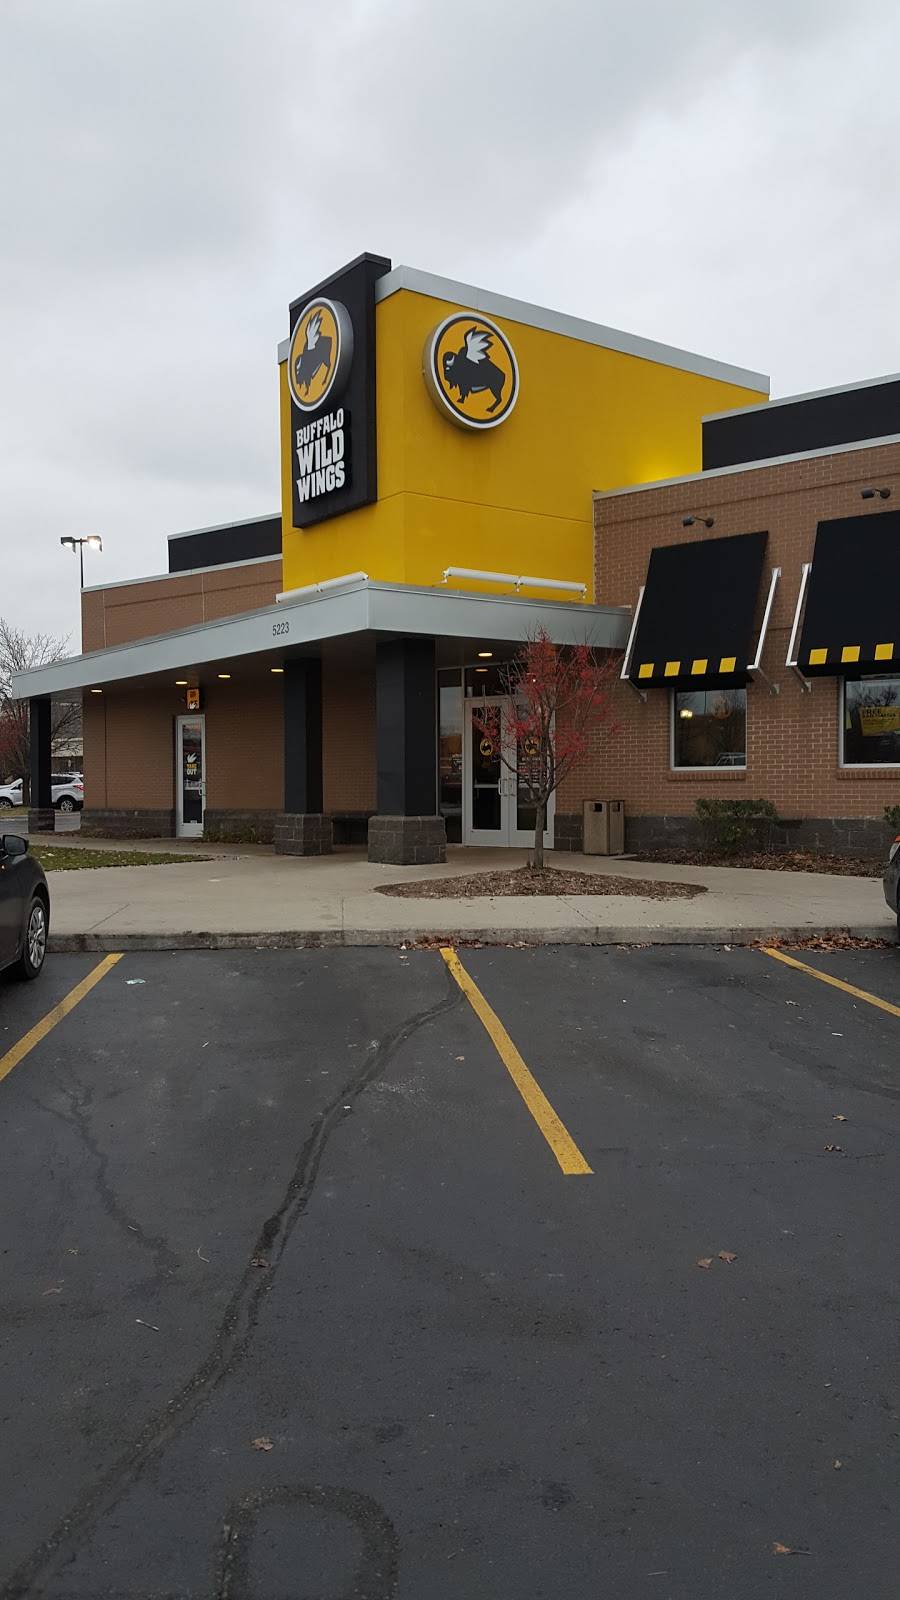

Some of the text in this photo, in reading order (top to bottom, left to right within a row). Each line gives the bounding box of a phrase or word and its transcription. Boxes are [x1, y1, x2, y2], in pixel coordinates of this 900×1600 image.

[296, 408, 344, 447] BUFFALO
[296, 429, 345, 477] WILD
[296, 460, 346, 503] WINGS
[272, 621, 290, 636] 5223
